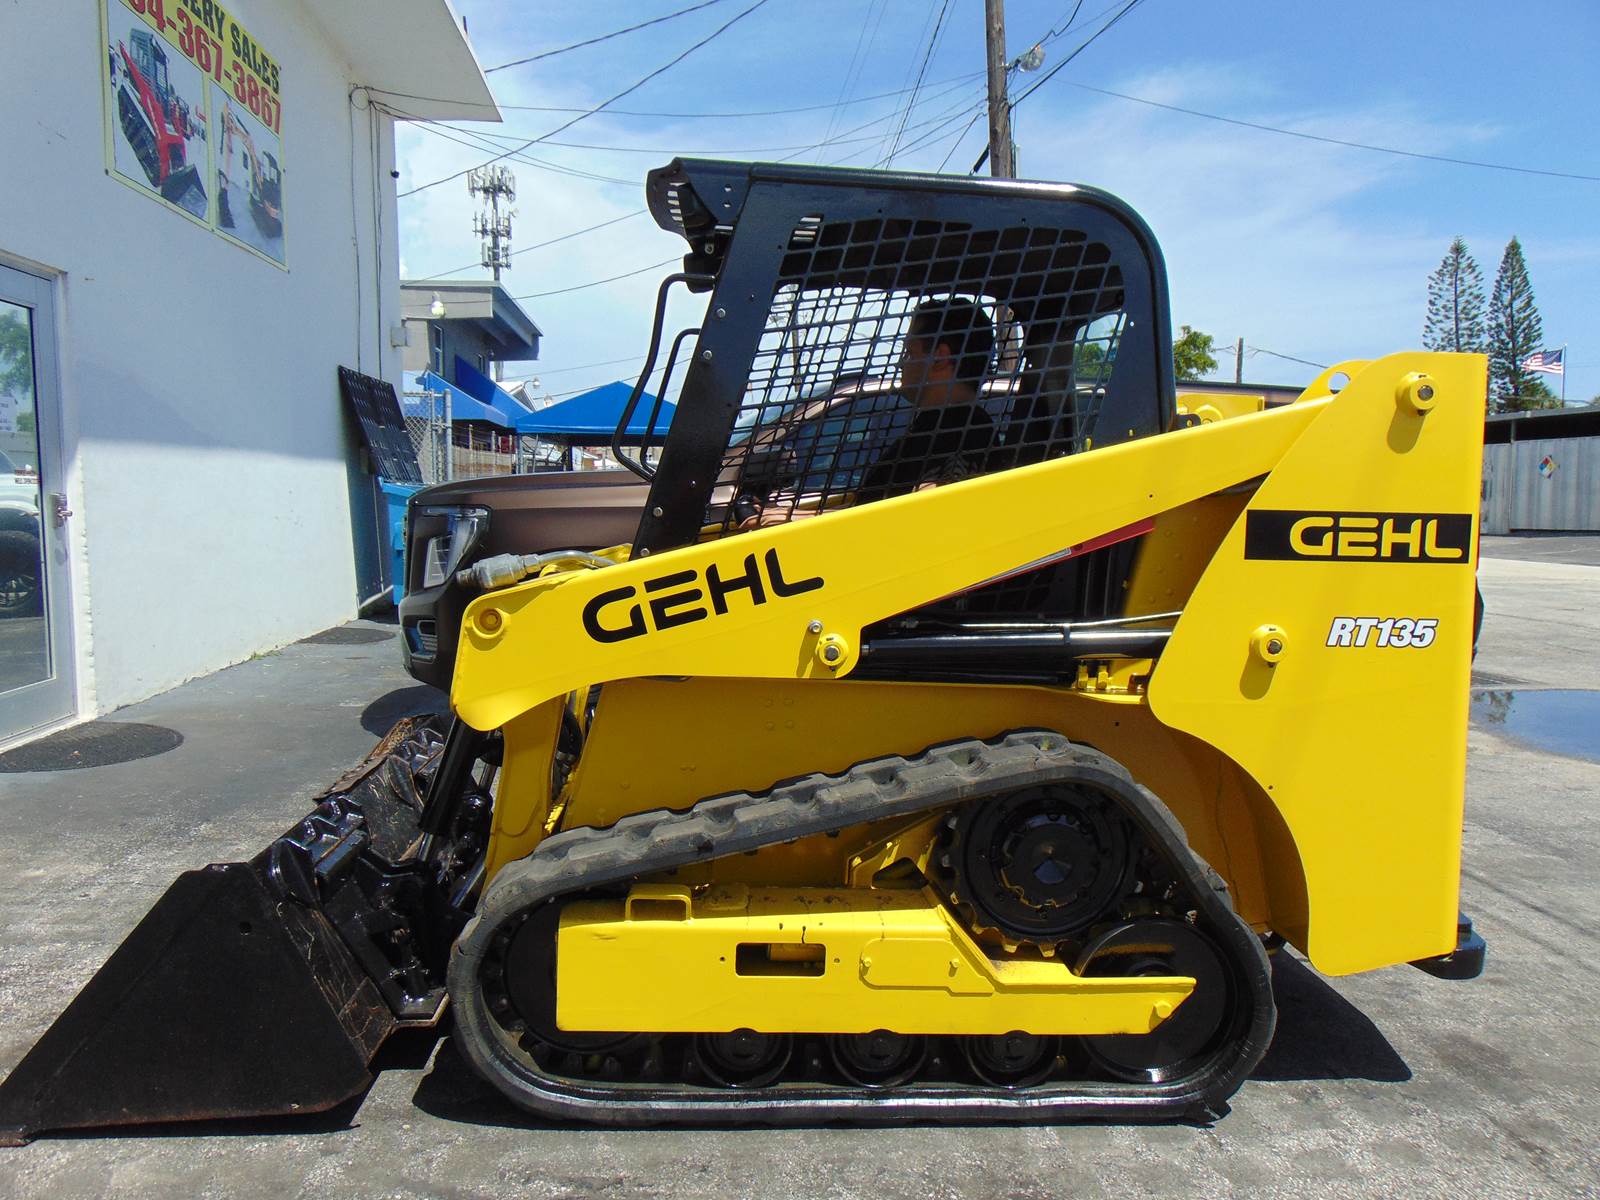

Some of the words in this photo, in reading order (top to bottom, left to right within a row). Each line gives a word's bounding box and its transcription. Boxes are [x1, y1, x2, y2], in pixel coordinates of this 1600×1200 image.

[230, 22, 281, 94] SALES
[1289, 516, 1463, 558] GEHL
[582, 547, 825, 643] GEHL
[1325, 617, 1439, 648] RT135
